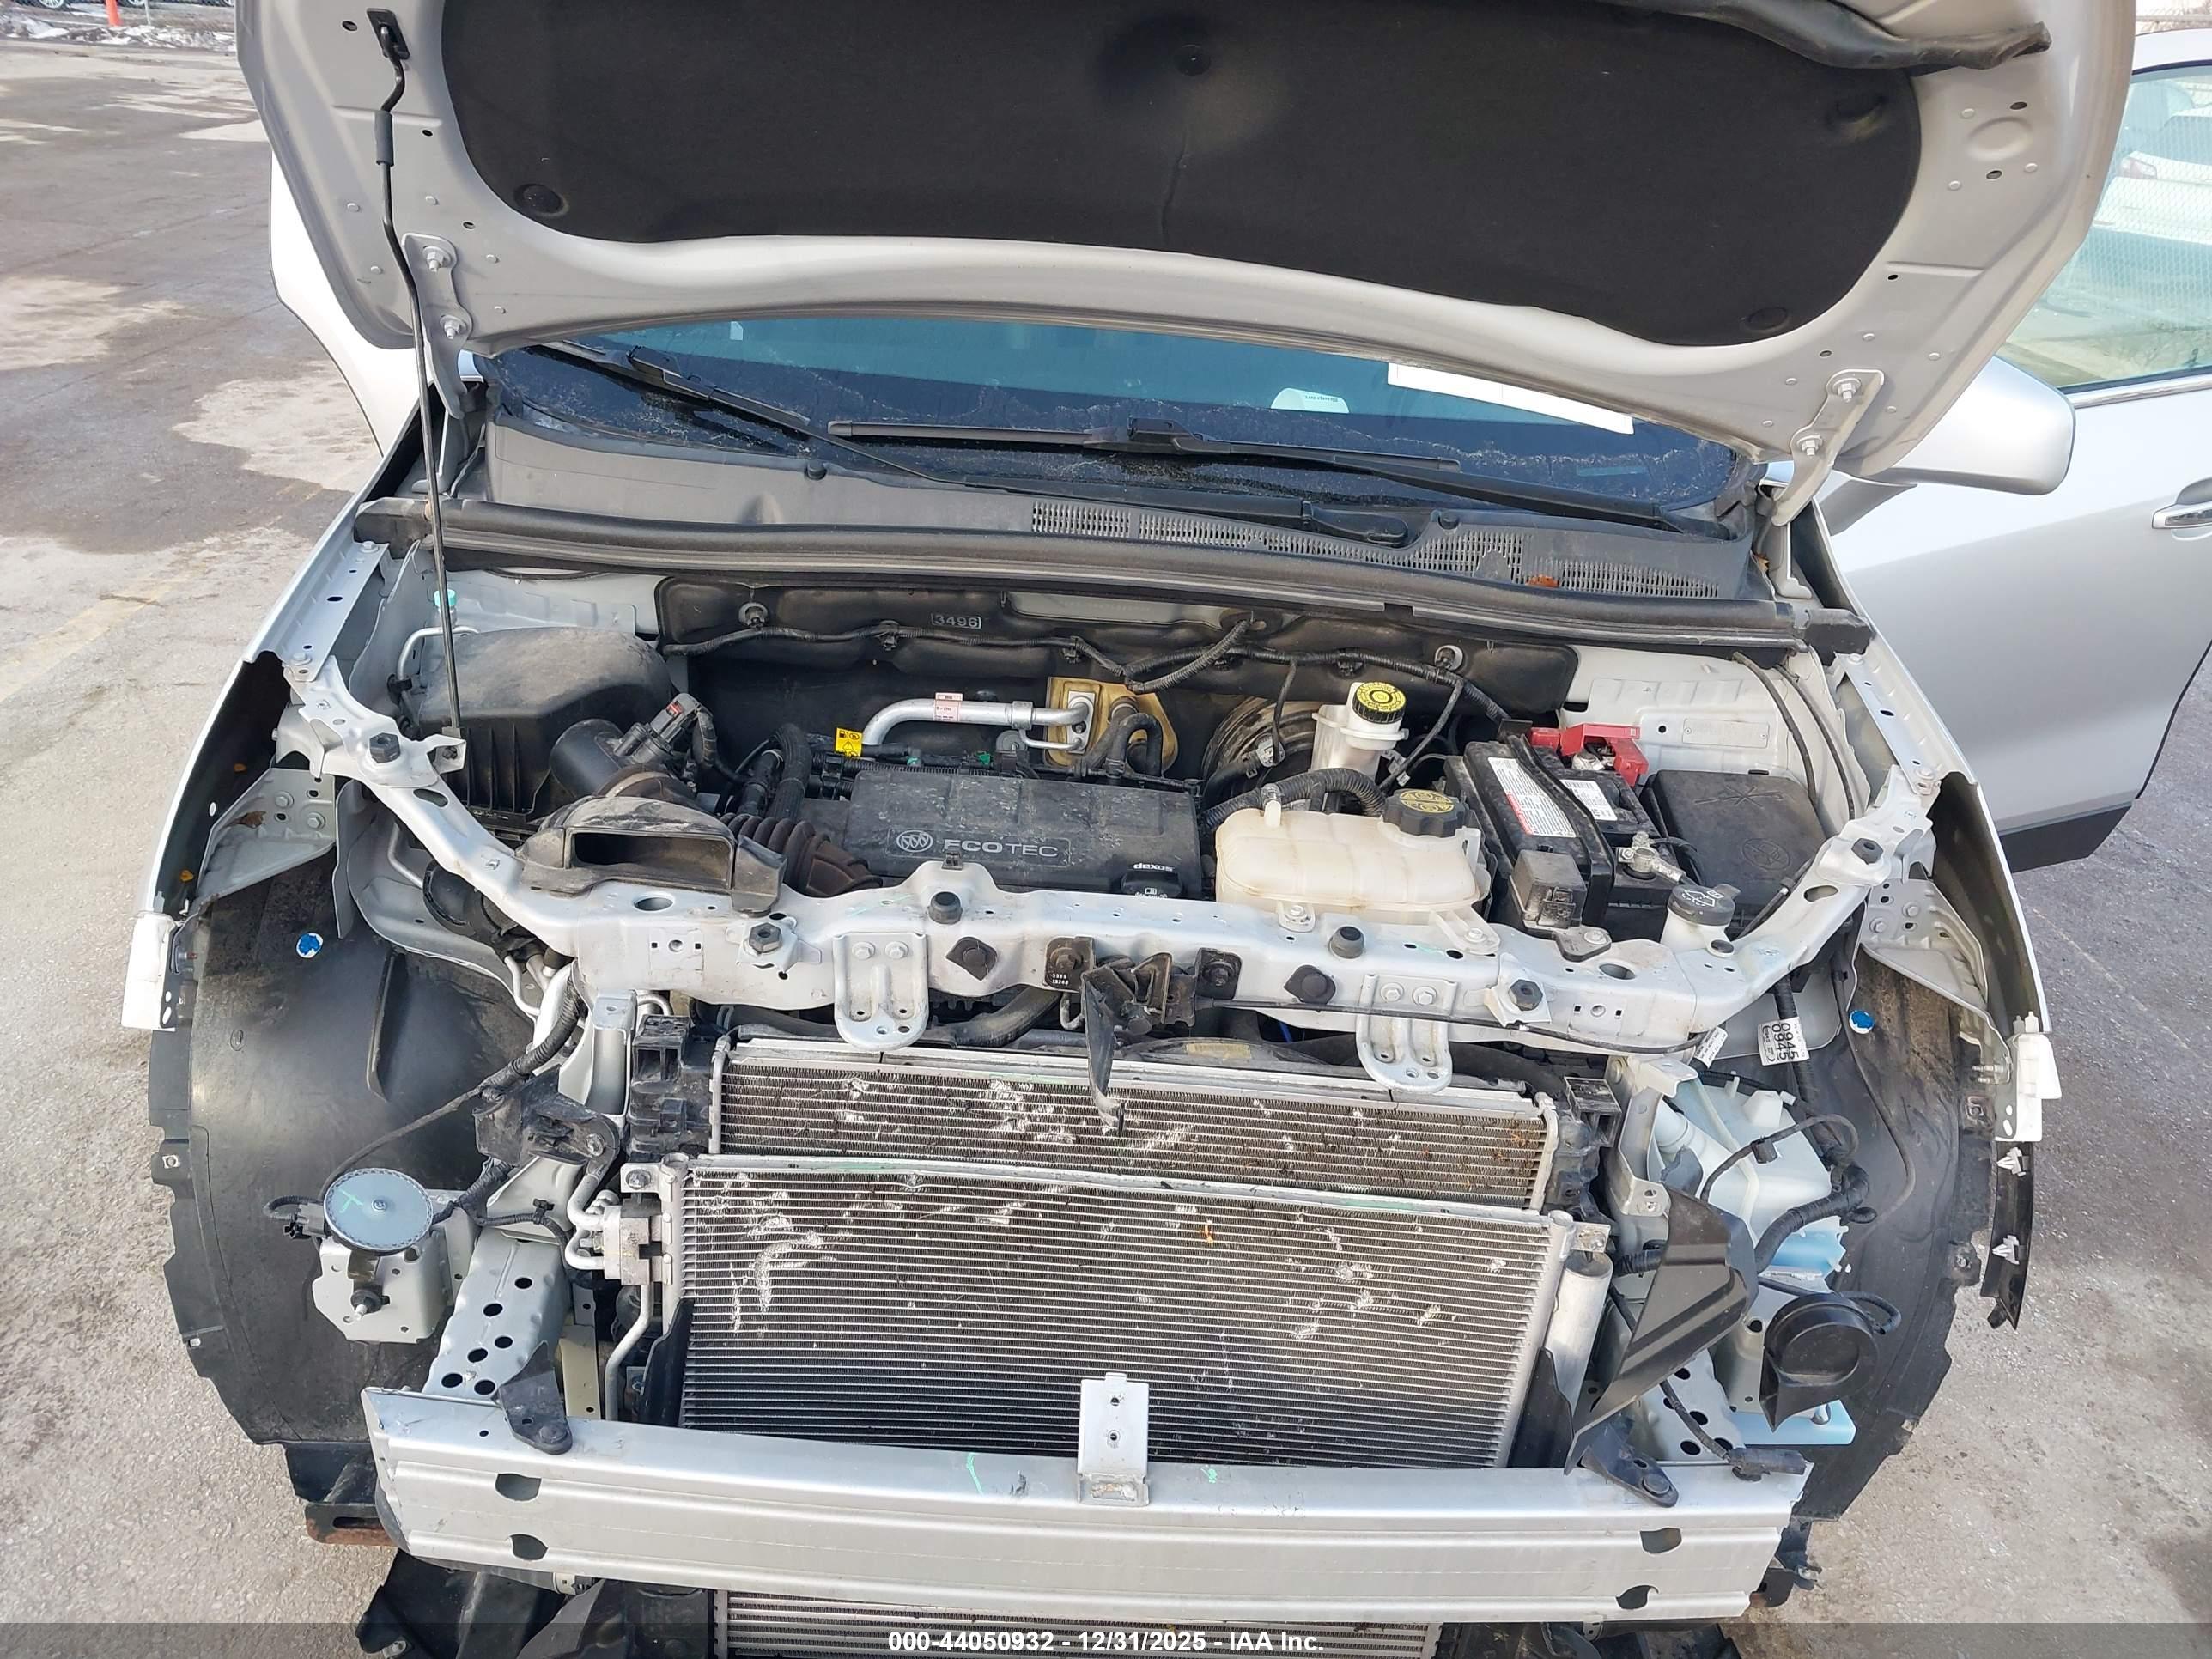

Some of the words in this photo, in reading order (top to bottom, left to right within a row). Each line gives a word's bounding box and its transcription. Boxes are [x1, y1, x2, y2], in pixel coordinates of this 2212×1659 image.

[935, 614, 978, 628] 3496
[944, 839, 1059, 857] ECOTEC
[1133, 862, 1173, 872] dexos
[1771, 1024, 1789, 1060] 0945
[1781, 1023, 1799, 1060] 0945
